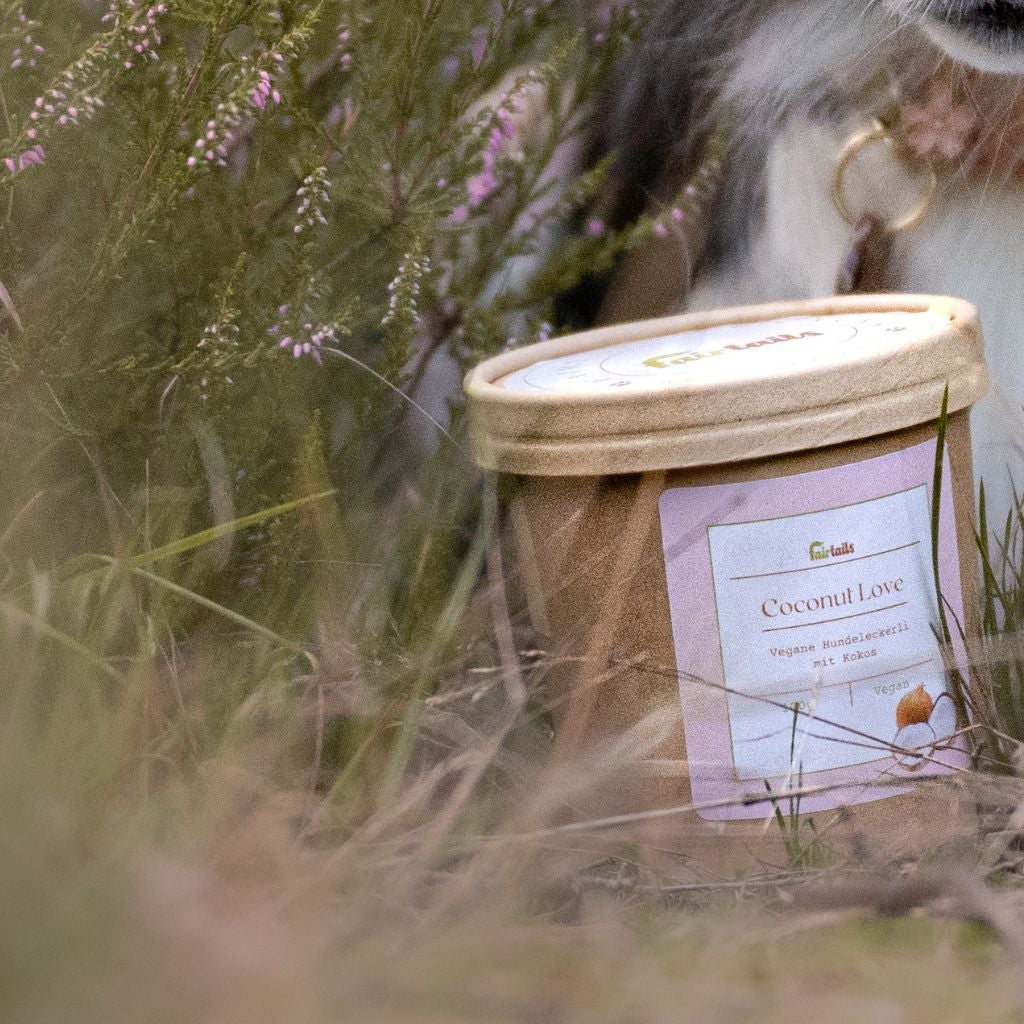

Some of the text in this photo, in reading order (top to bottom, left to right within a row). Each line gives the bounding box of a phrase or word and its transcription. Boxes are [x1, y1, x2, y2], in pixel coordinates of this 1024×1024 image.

[761, 578, 904, 618] Coconut Love
[769, 621, 910, 658] Vegane Hundeleckerli
[813, 648, 878, 668] mit Kokos
[872, 680, 910, 696] Vegan
